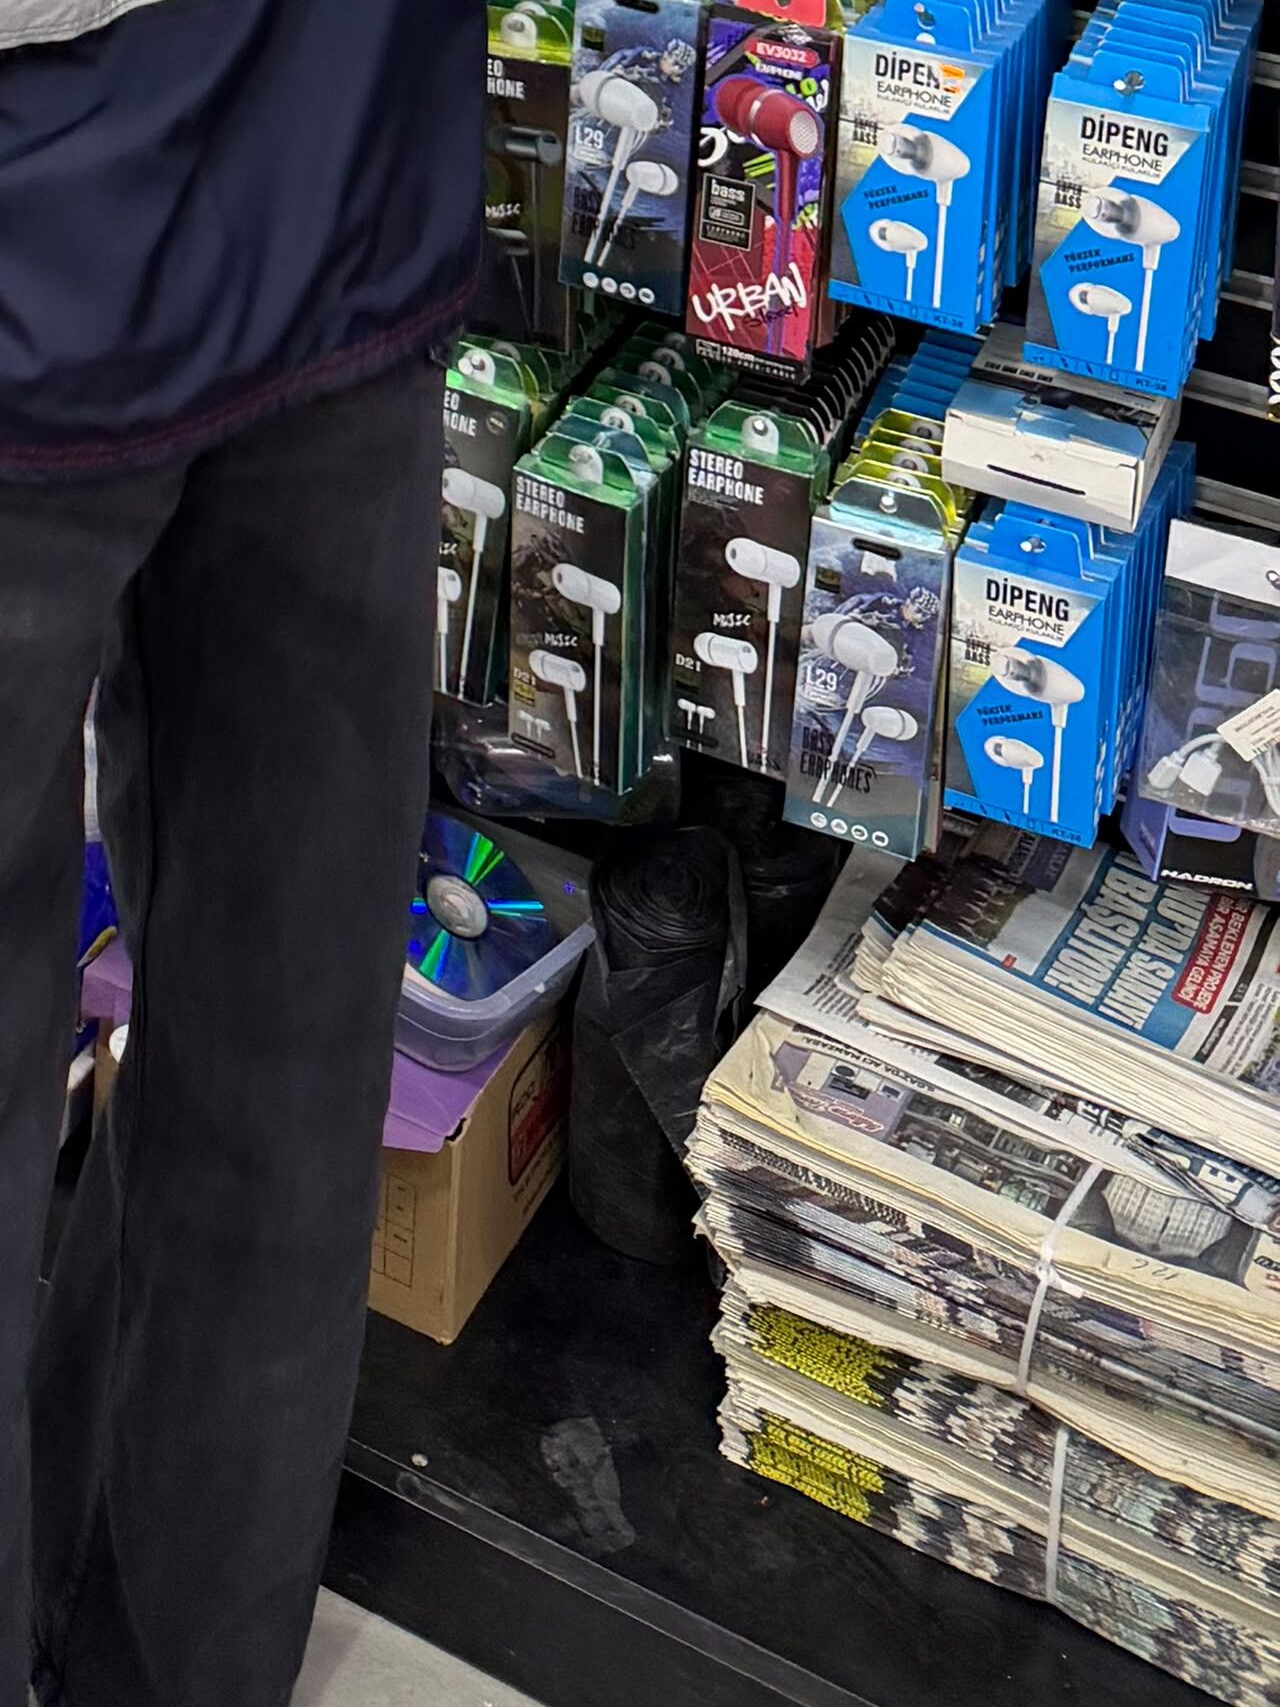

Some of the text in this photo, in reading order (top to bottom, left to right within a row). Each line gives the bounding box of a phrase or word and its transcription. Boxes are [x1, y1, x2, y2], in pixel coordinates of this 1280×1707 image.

[756, 41, 807, 65] EV3032
[874, 51, 942, 89] DİPEN
[877, 80, 952, 108] EARPHONE
[575, 124, 604, 149] L29
[853, 130, 879, 147] BASS
[1082, 143, 1163, 172] EARPHONE
[710, 179, 746, 203] bass
[1054, 191, 1082, 209] BASS
[692, 261, 807, 331] URBAN
[689, 447, 744, 479] STEREO
[515, 474, 566, 508] STEREO
[687, 467, 765, 506] EARPHONE
[514, 495, 585, 535] EARPHONE
[712, 612, 752, 628] MUSIC
[988, 605, 1065, 637] EARPHONE
[674, 652, 702, 672] D21
[964, 649, 991, 667] BASS
[805, 665, 838, 693] L29
[1160, 868, 1254, 892] HADRON
[1043, 864, 1157, 1004] BAŞLIYOR!
[1136, 883, 1211, 966] NU'DA
[1194, 912, 1226, 969] AŞAMAYA
[1212, 911, 1246, 971] BEKLENEN
[1098, 949, 1174, 1030] SANAYİ
